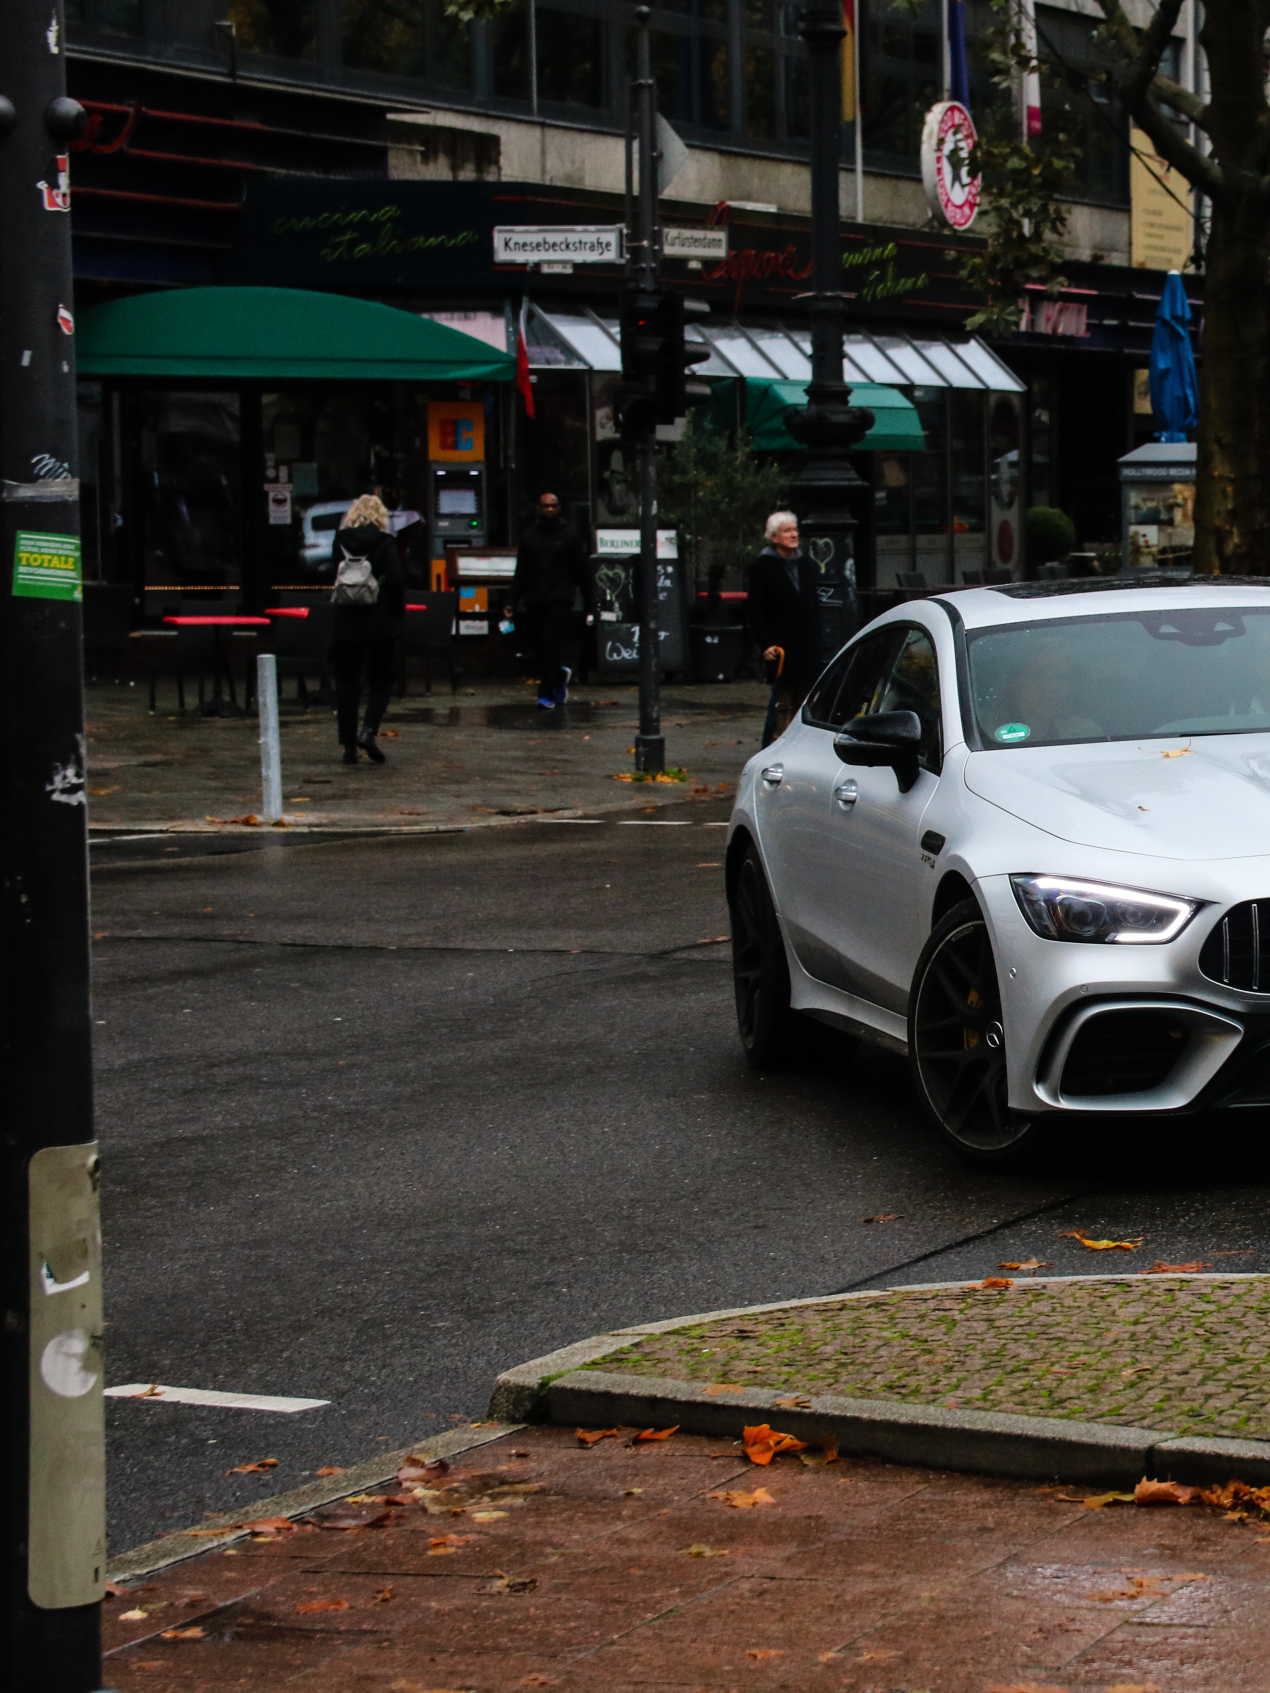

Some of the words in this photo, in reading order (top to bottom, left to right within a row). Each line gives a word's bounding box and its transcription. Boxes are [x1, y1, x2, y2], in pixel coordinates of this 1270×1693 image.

[503, 237, 612, 255] Knesebeckstraße
[664, 231, 722, 248] Kurfürstendamm
[599, 538, 641, 549] BERLINER
[19, 553, 75, 569] TOTALE
[606, 641, 639, 660] Wei
